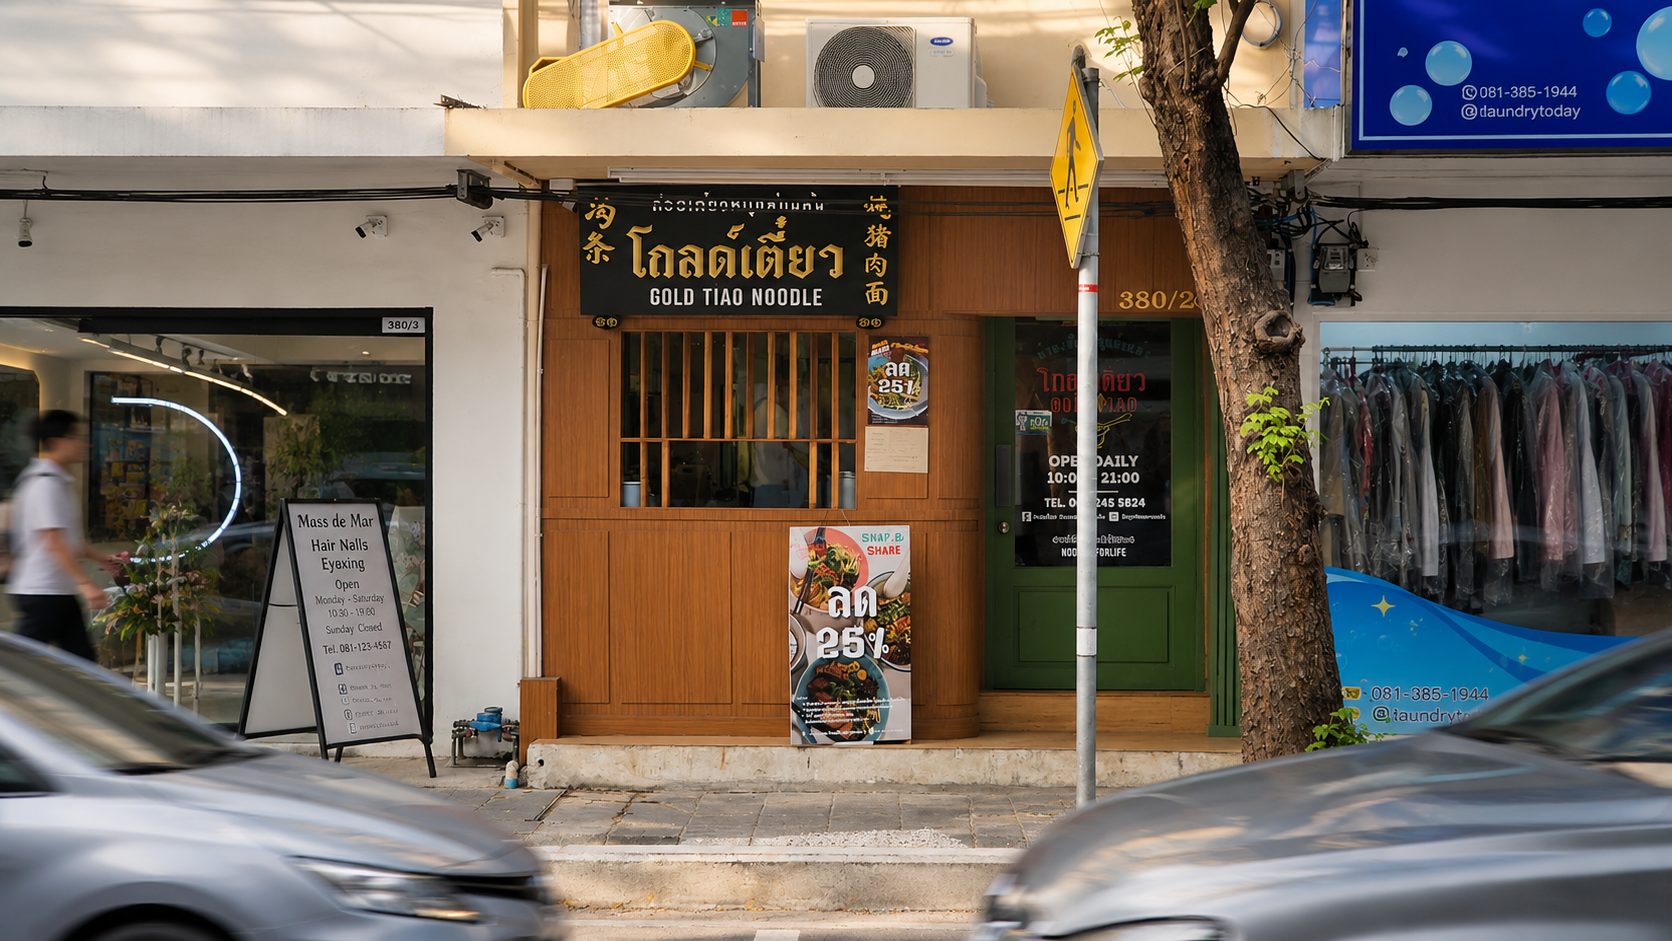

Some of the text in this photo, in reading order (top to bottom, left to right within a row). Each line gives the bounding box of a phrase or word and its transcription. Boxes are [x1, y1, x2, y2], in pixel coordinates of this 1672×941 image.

[1479, 86, 1578, 98] 081-385-1944
[650, 287, 823, 306] GOLD TIAO NOODLE
[388, 320, 419, 330] 380/3
[1048, 455, 1078, 468] OPE
[1047, 472, 1140, 484] 10:0 21:00
[1044, 498, 1066, 508] TEL.
[332, 513, 346, 528] de
[350, 513, 374, 528] Mar
[311, 539, 336, 552] Hair
[867, 545, 901, 556] SHARE
[335, 579, 360, 591] Open
[828, 586, 877, 618] ลด
[325, 625, 354, 635] Sunday
[816, 626, 889, 659] 25%
[1371, 686, 1489, 701] 081-385-1944
